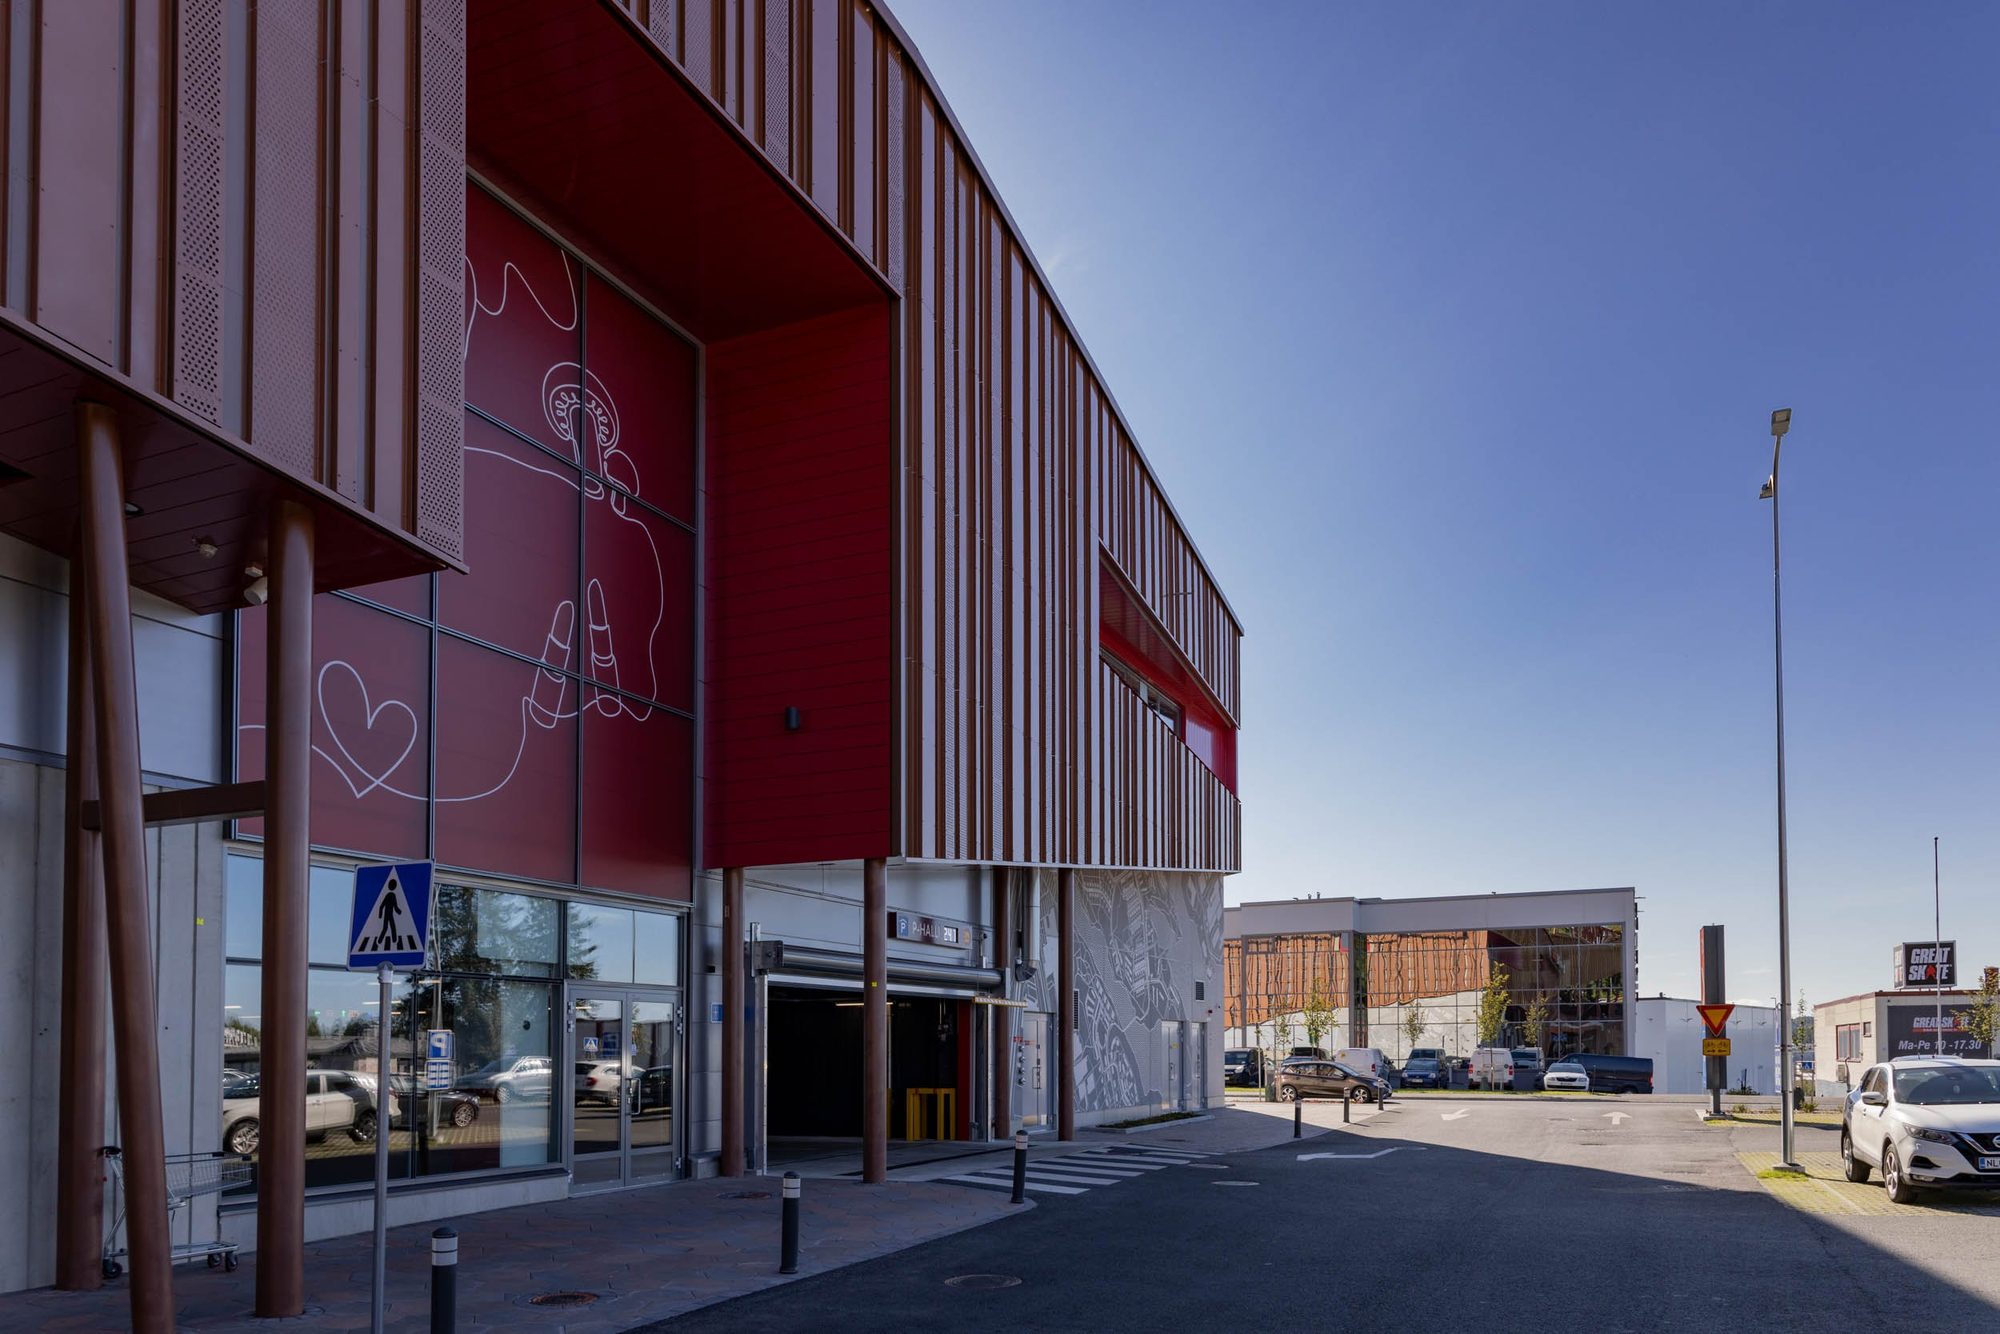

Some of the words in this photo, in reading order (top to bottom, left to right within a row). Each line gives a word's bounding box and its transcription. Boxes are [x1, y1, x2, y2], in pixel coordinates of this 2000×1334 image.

[1911, 948, 1950, 963] GREAT
[1913, 1017, 1941, 1028] GREA
[1898, 1040, 1930, 1050] Ma-Pe
